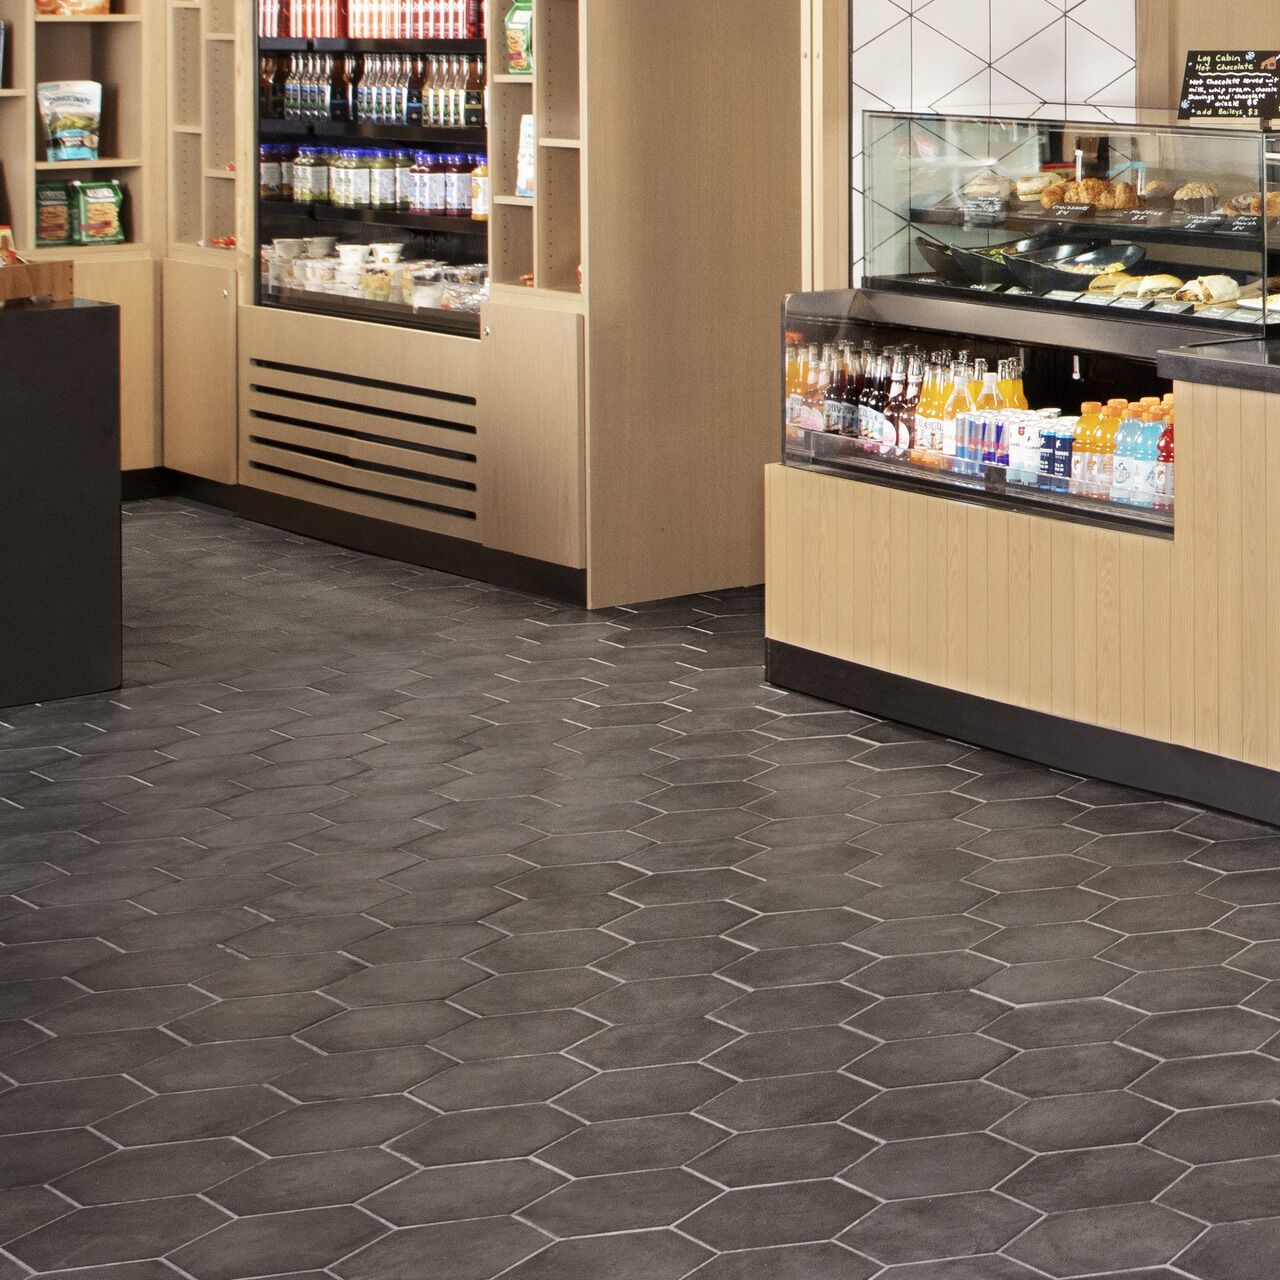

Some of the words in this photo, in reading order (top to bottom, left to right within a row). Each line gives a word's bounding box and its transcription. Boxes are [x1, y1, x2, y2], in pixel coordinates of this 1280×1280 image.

[1197, 55, 1211, 65] Log
[1209, 86, 1226, 94] whip
[1218, 108, 1243, 116] Baileys
